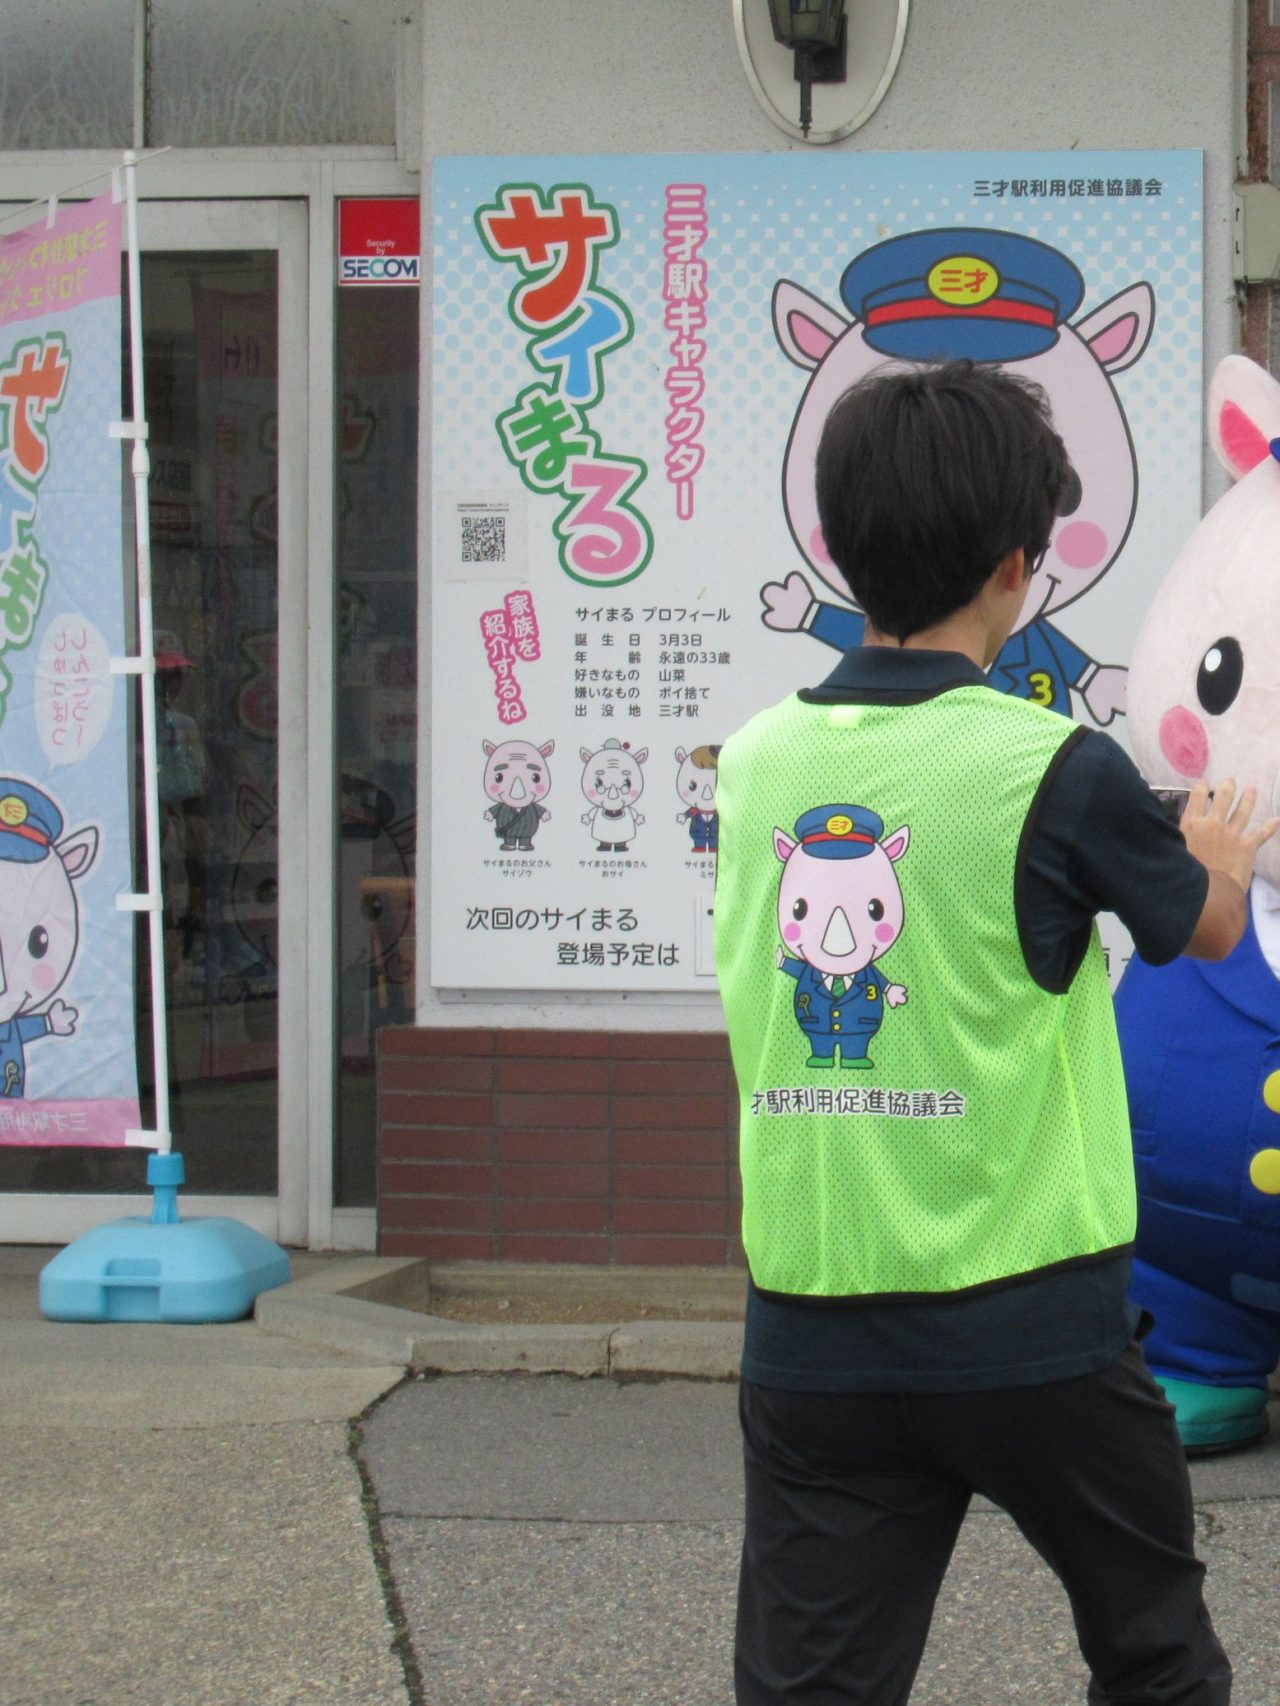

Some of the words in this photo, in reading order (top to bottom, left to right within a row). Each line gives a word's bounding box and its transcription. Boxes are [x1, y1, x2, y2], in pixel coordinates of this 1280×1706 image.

[973, 178, 1162, 197] 三才駅利用促進協議会
[366, 239, 396, 249] Security
[376, 247, 386, 255] by
[343, 258, 418, 278] SECOM
[939, 268, 988, 293] 三才
[664, 184, 707, 520] 三才駅キャラクター
[478, 187, 650, 583] サイまる
[574, 607, 635, 623] サイまる
[642, 606, 732, 623] プロフィール
[506, 591, 539, 660] 家族を
[658, 633, 702, 648] 3月3日
[481, 611, 527, 724] 紹介するね
[658, 651, 731, 665] 永遠の33歳
[574, 668, 641, 683] 好きなもの
[658, 669, 686, 683] 山菜
[574, 686, 641, 700] 嫌いなもの
[1029, 672, 1053, 707] 3
[658, 705, 700, 718] 三才駅
[466, 907, 639, 932] 次回のサイまる
[556, 942, 680, 967] 登場予定は
[866, 984, 878, 1001] 3
